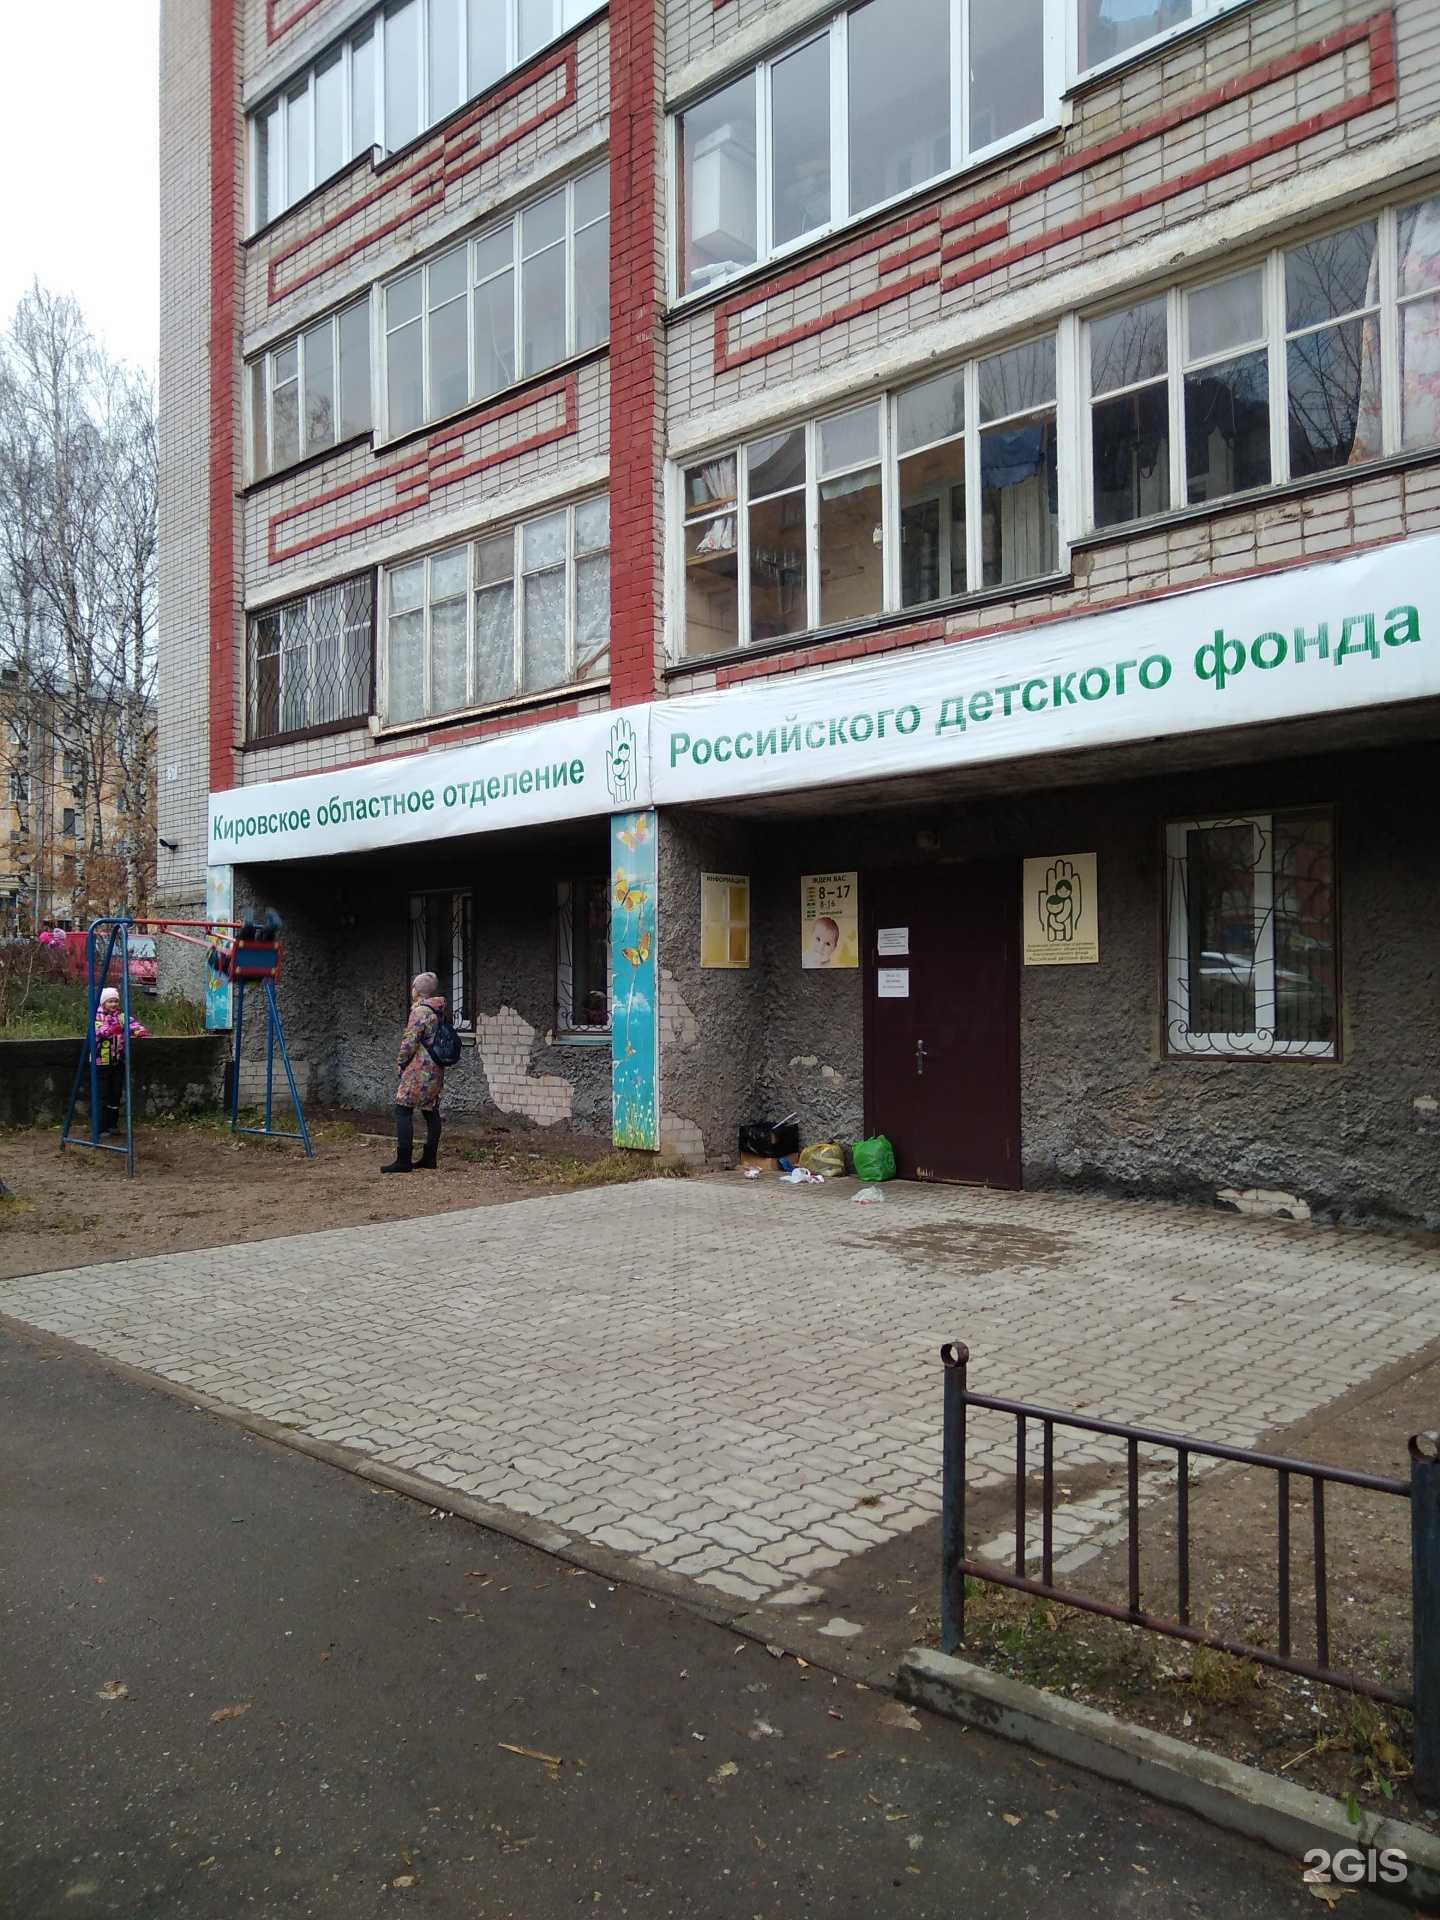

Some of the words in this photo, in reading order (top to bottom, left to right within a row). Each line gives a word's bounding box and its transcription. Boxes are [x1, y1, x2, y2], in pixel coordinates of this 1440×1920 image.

[670, 700, 921, 768] Российского
[935, 655, 1172, 736] детского
[1194, 605, 1421, 690] фонда
[213, 807, 311, 844] Кировское
[316, 790, 434, 827] областное
[442, 757, 585, 808] отделение
